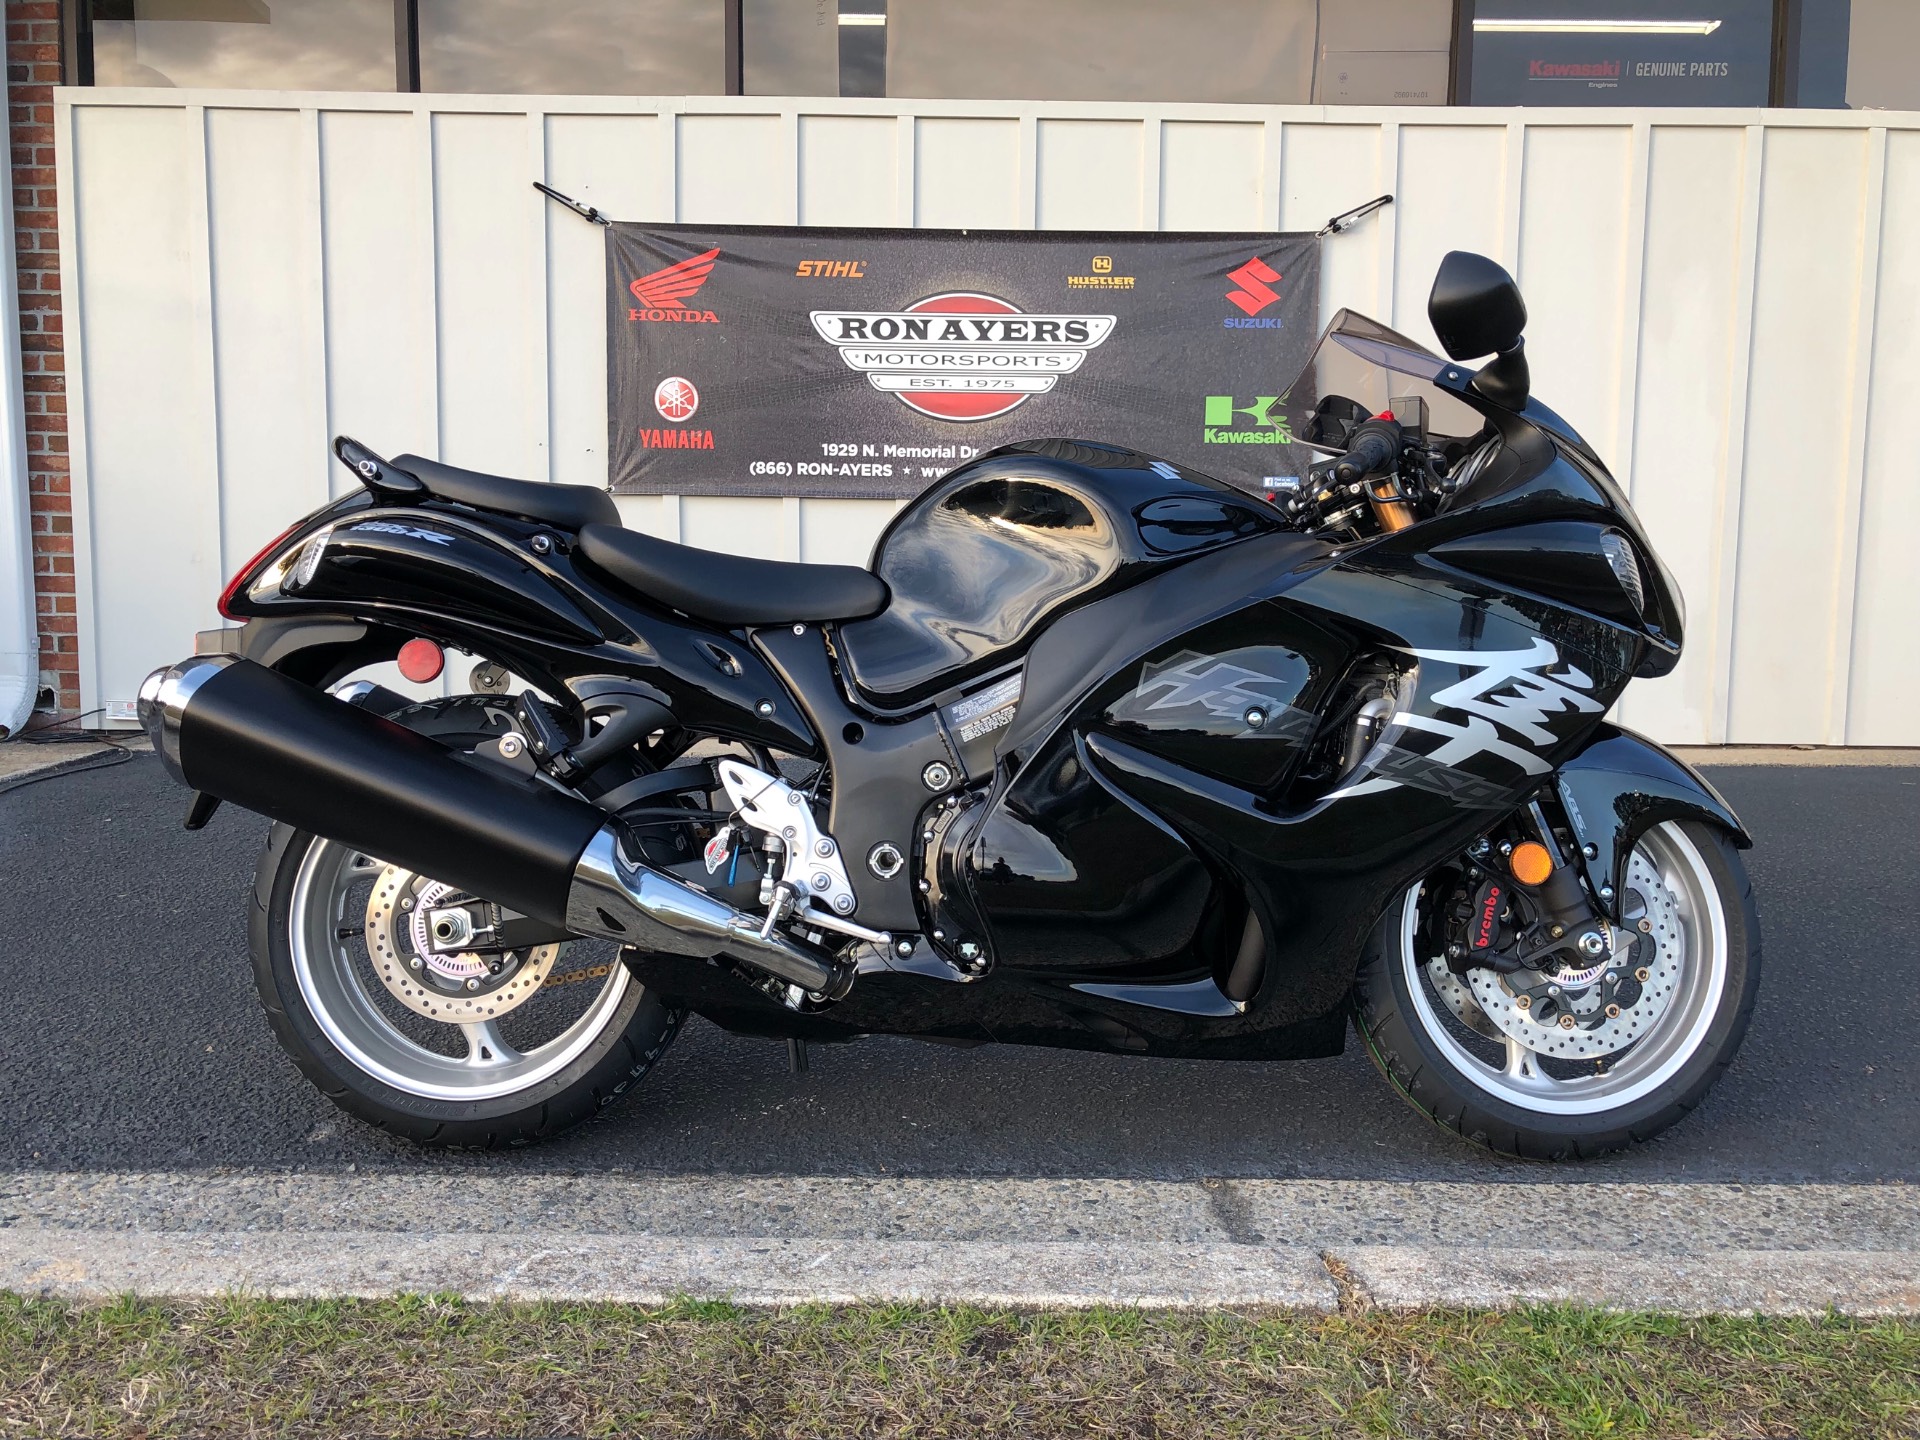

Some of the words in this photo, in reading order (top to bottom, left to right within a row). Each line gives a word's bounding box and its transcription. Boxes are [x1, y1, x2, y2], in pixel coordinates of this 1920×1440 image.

[1529, 60, 1620, 77] Kawasaki
[1635, 62, 1687, 77] GENUINE
[1690, 62, 1728, 77] PARTS
[796, 260, 864, 278] STIHL
[1067, 276, 1136, 285] HUSTLER
[628, 308, 720, 323] HONDA
[1223, 318, 1282, 329] SUZUKI
[837, 318, 933, 340] RON
[938, 319, 1090, 343] AYERS
[864, 353, 1061, 367] MOTORSPORTS
[909, 378, 952, 387] EST.
[964, 380, 1015, 388] 1975
[640, 429, 714, 449] YAMAHA
[1204, 428, 1291, 444] Kawasaki
[822, 443, 858, 457] 1929
[862, 445, 879, 457] N.
[883, 445, 955, 458] Memorial
[749, 461, 793, 476] (866)
[797, 463, 892, 477] RON-AYERS
[1475, 887, 1500, 947] brembo
